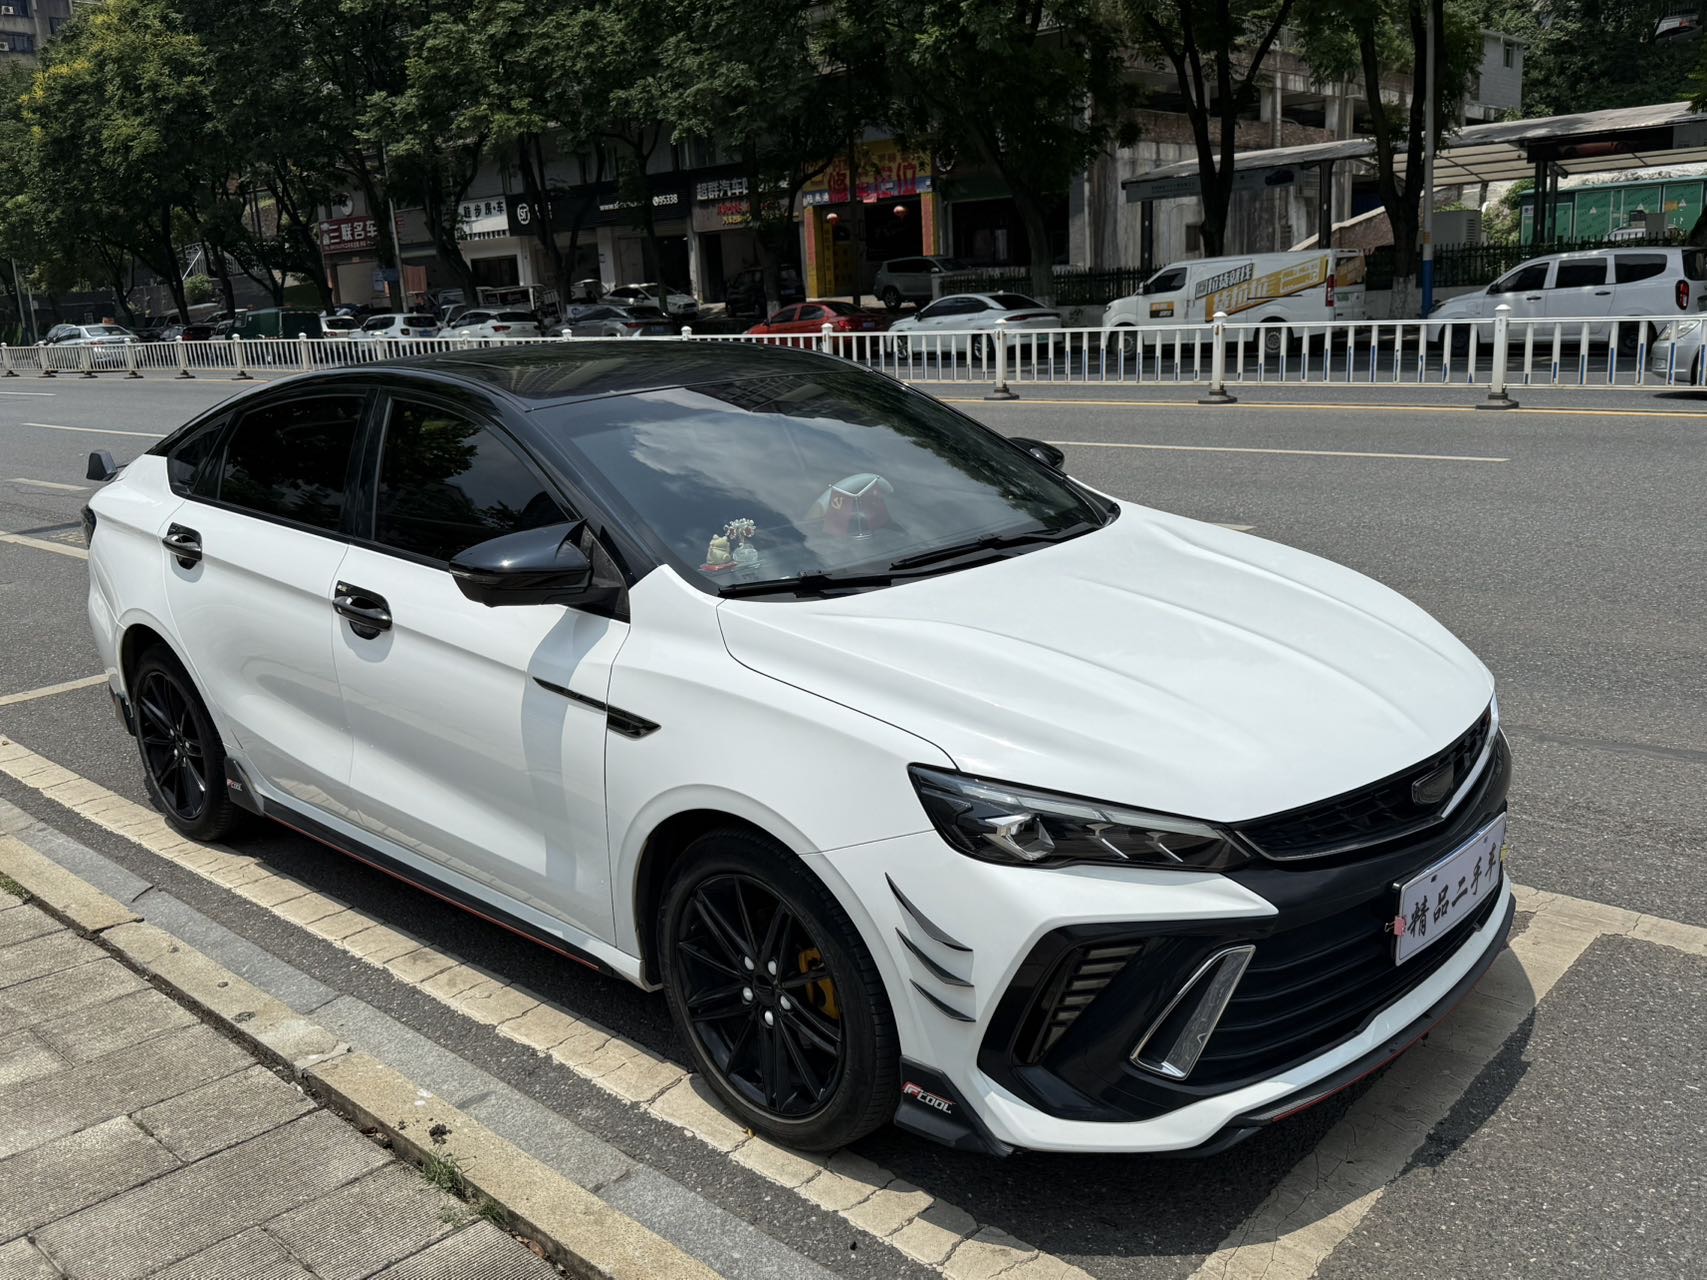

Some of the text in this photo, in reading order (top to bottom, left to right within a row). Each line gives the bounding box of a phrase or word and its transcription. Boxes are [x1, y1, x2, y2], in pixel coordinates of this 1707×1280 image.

[697, 175, 769, 200] 超群汽车
[1407, 842, 1497, 938] 精品二手车
